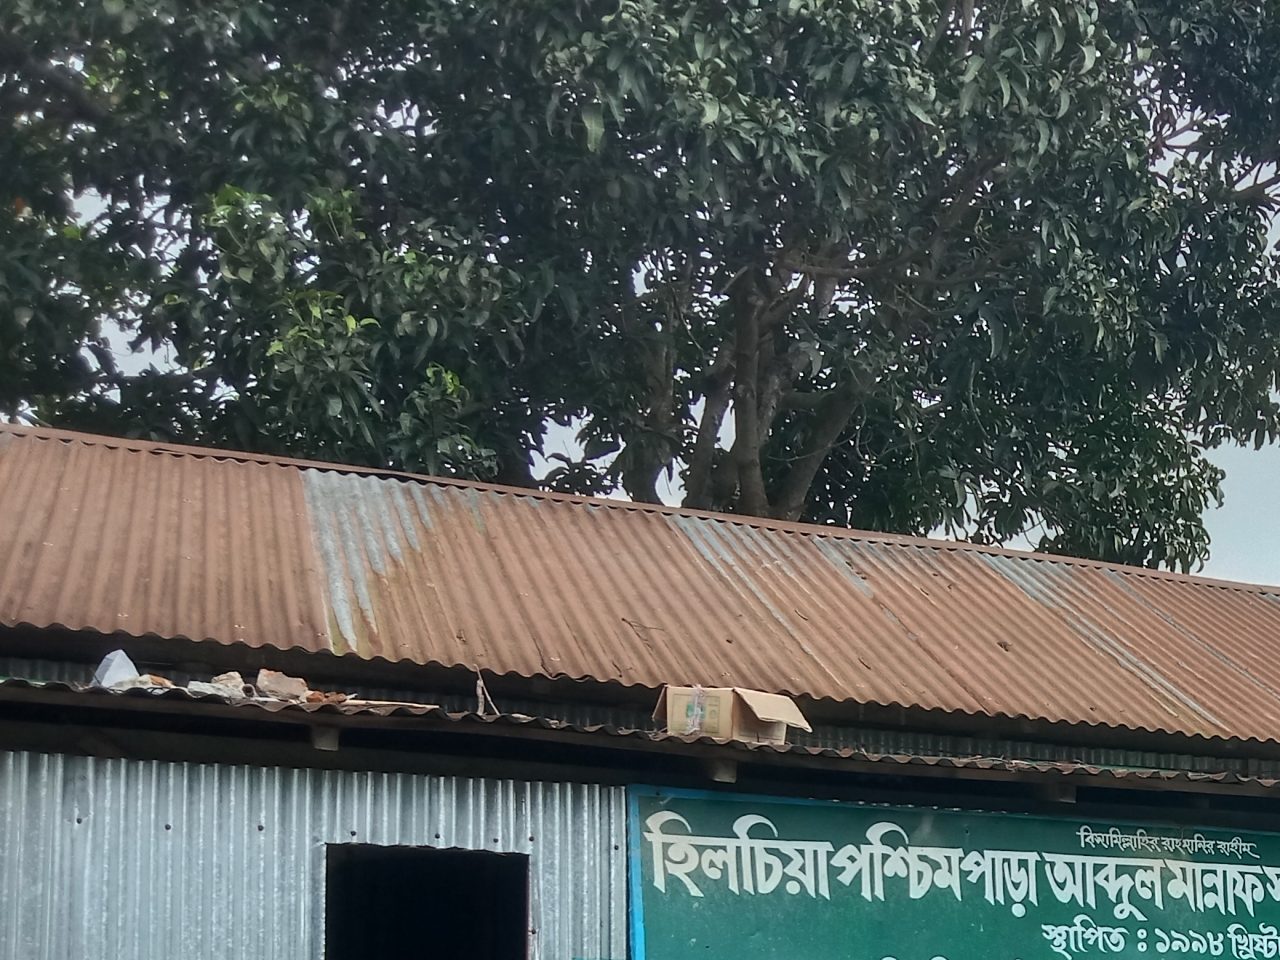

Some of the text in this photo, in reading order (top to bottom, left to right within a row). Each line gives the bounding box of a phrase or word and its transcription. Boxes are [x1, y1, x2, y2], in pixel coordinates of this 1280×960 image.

[642, 810, 835, 900] হিলচিয়া
[829, 821, 965, 902] পশ্চিম
[959, 849, 1042, 918] পাড়া
[1042, 852, 1167, 921] আব্দুল
[1163, 858, 1265, 918] মান্নাফ
[1154, 928, 1224, 956] ১৯৯৮
